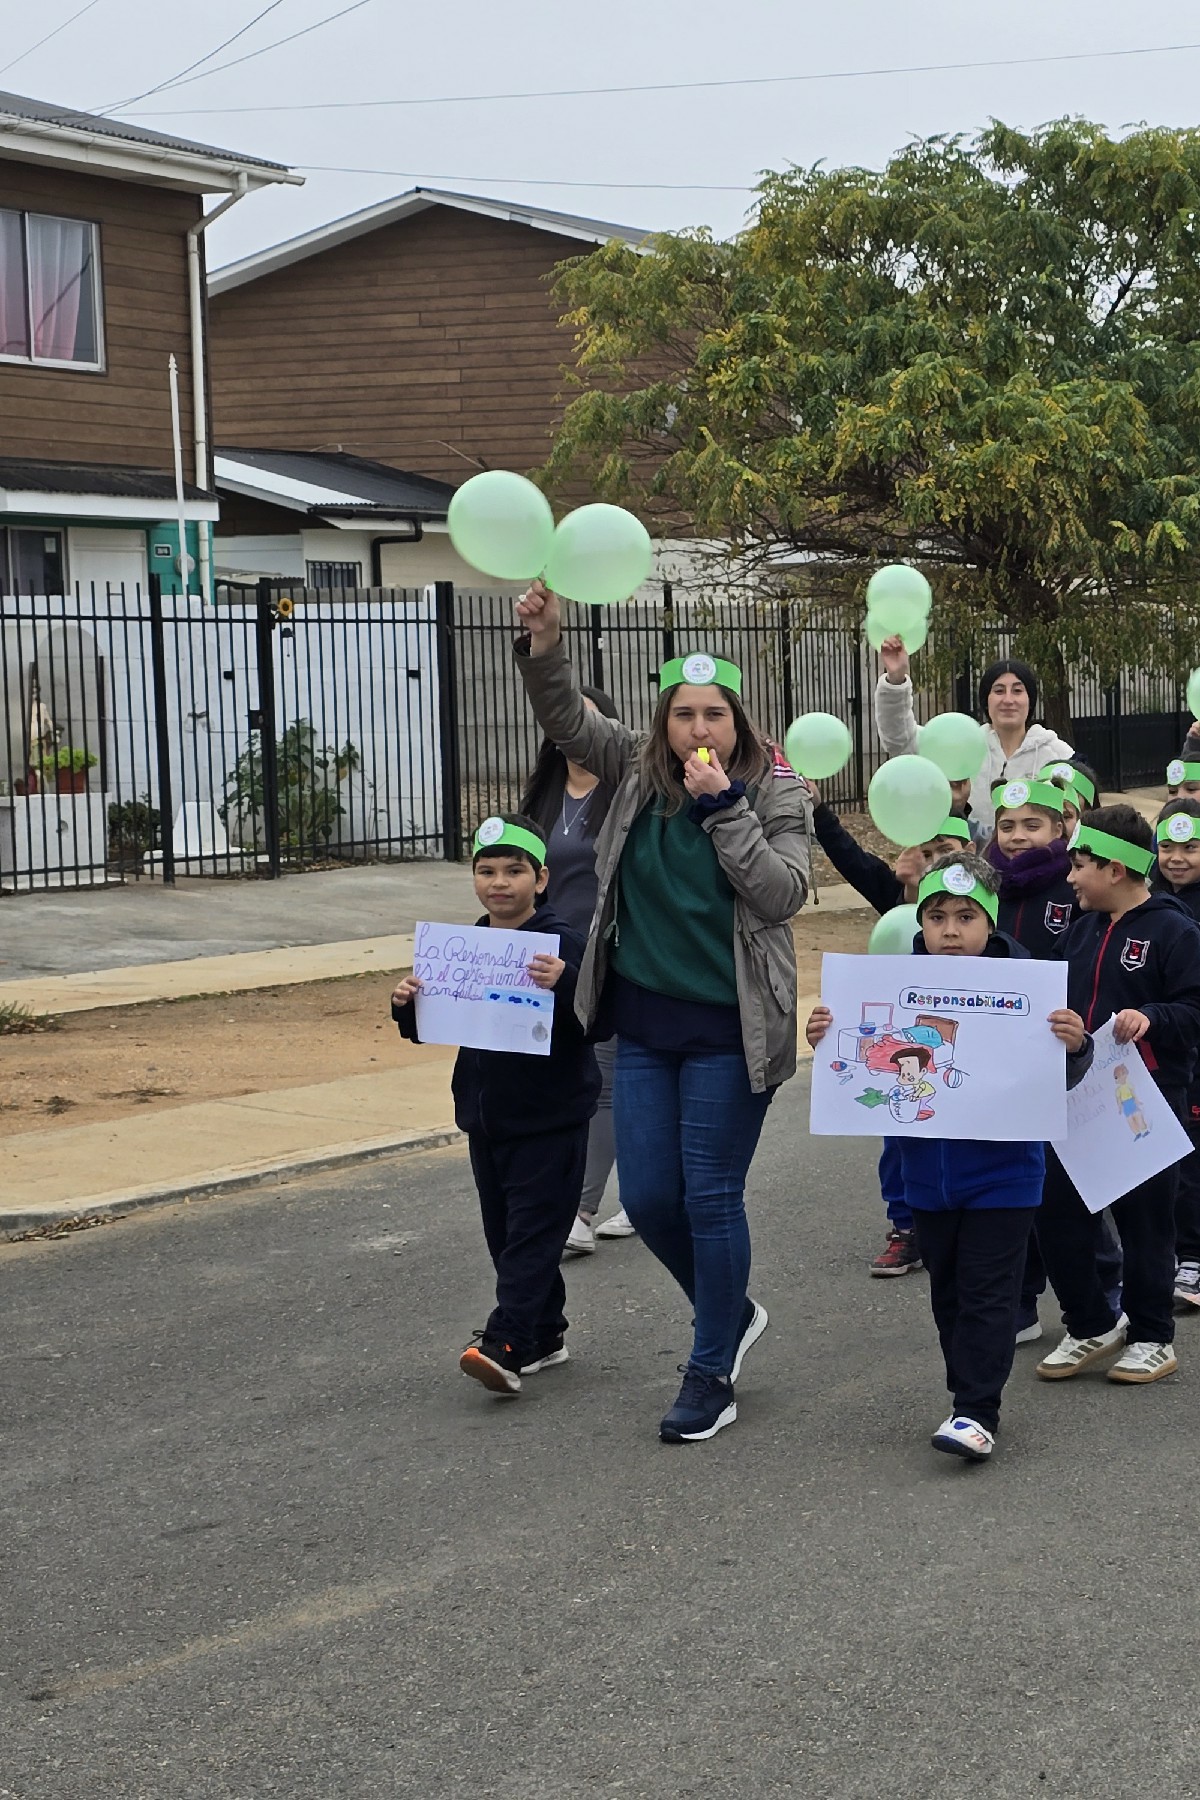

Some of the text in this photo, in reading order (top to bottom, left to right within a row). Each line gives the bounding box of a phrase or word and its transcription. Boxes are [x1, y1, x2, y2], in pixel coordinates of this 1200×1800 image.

[414, 922, 552, 968] La Responsabil
[906, 991, 1023, 1010] Responsabilidad
